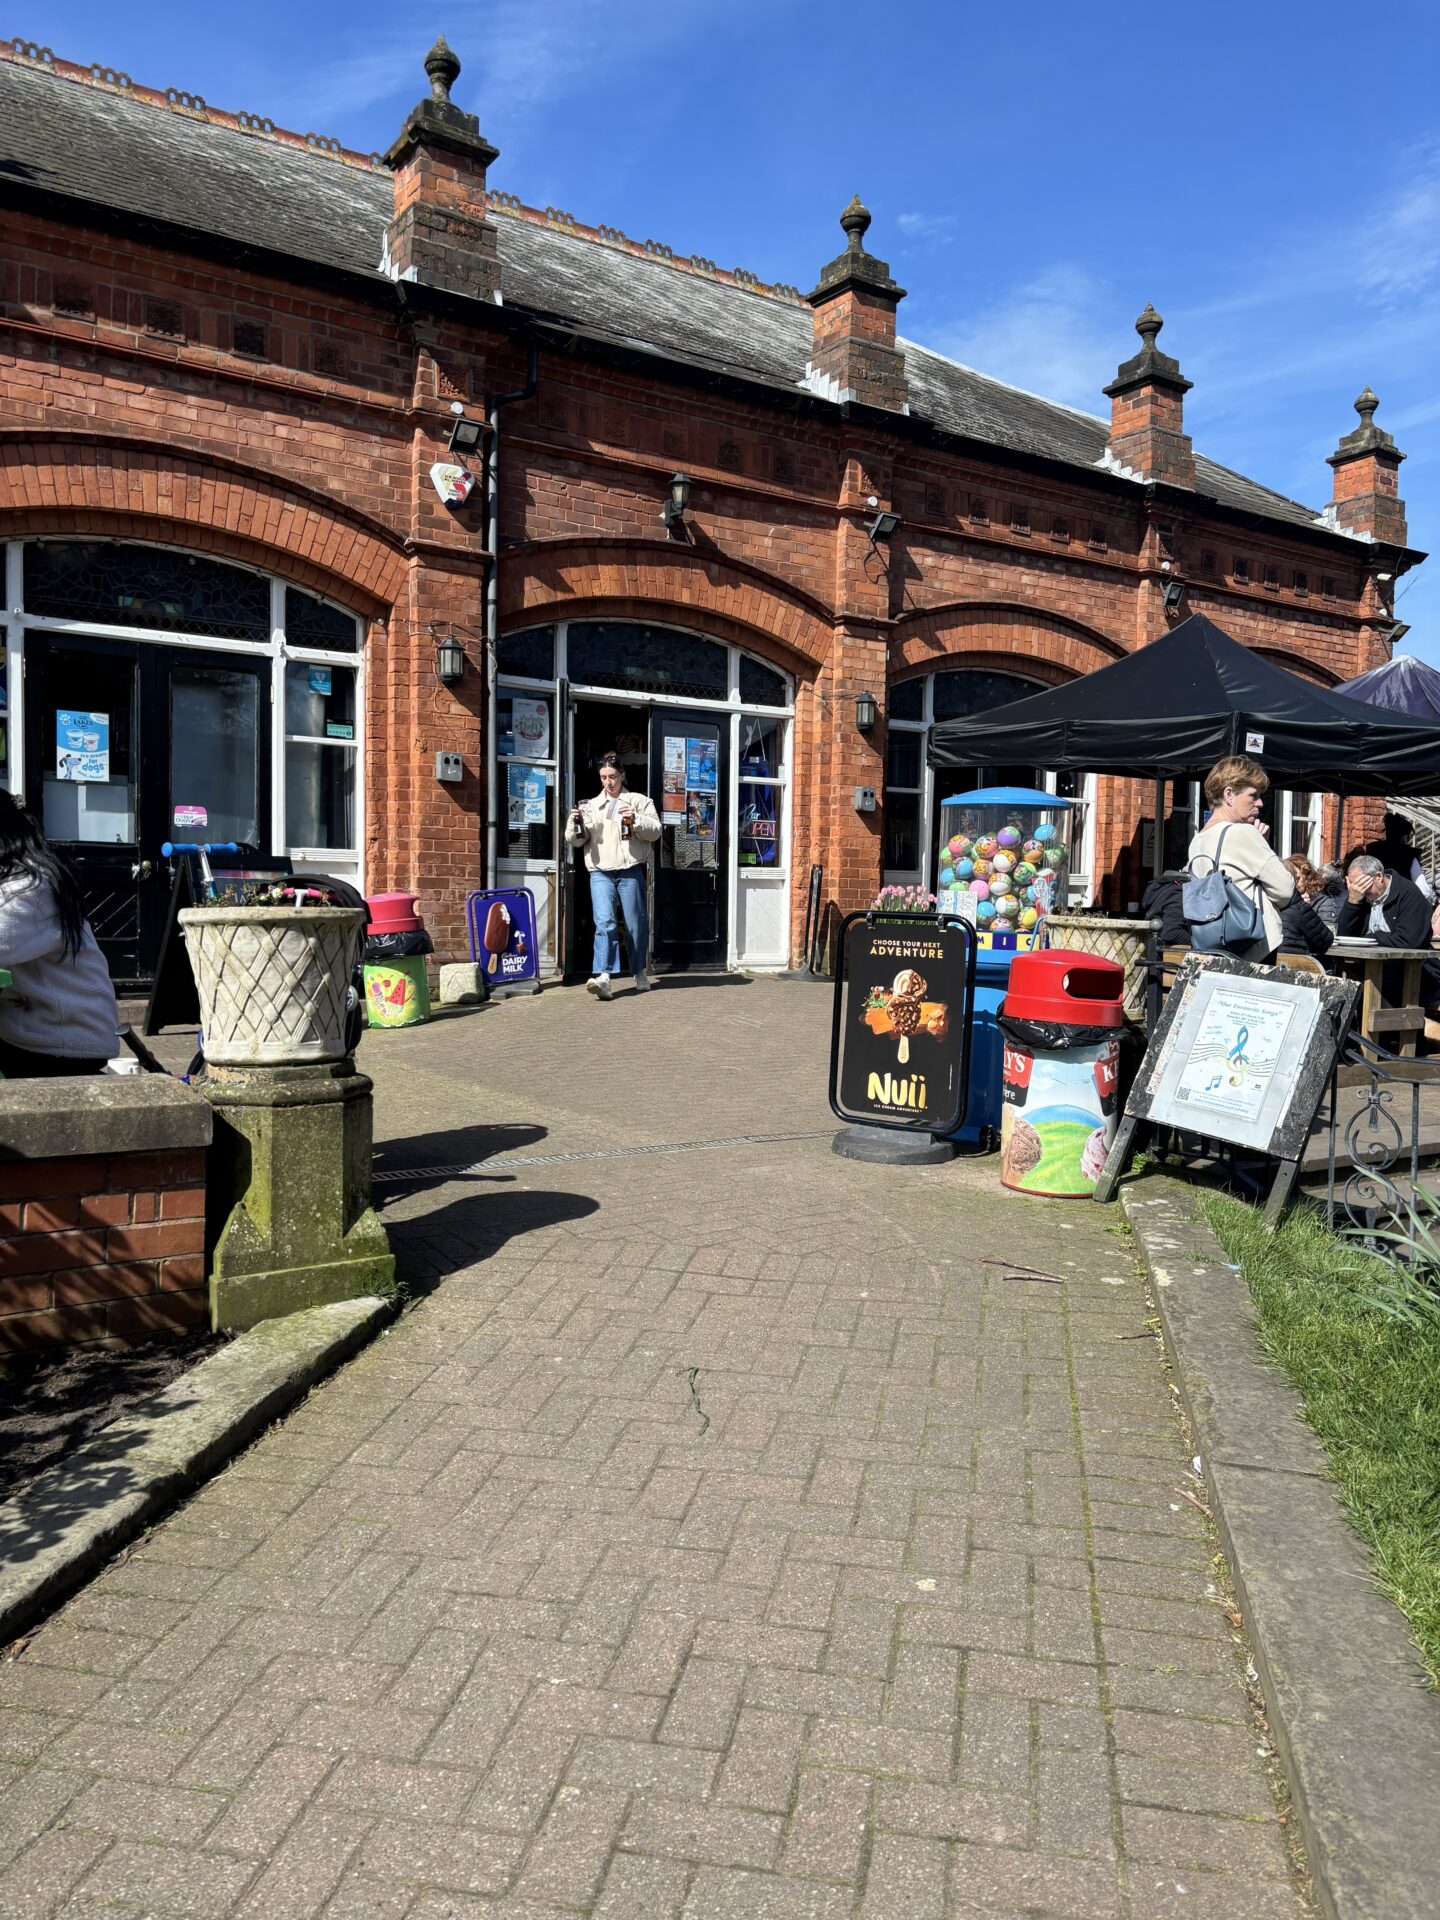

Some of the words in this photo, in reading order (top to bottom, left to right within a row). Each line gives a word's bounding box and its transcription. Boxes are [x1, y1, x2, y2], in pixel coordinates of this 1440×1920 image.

[82, 763, 104, 773] dogs
[527, 808, 542, 816] dogs
[748, 822, 775, 837] OPEN
[872, 939, 900, 947] CHOOSE
[902, 940, 920, 948] YOUR
[869, 946, 944, 959] ADVENTURE
[502, 955, 528, 966] DAIRY
[502, 963, 524, 974] MILK
[867, 1072, 927, 1109] Nuii
